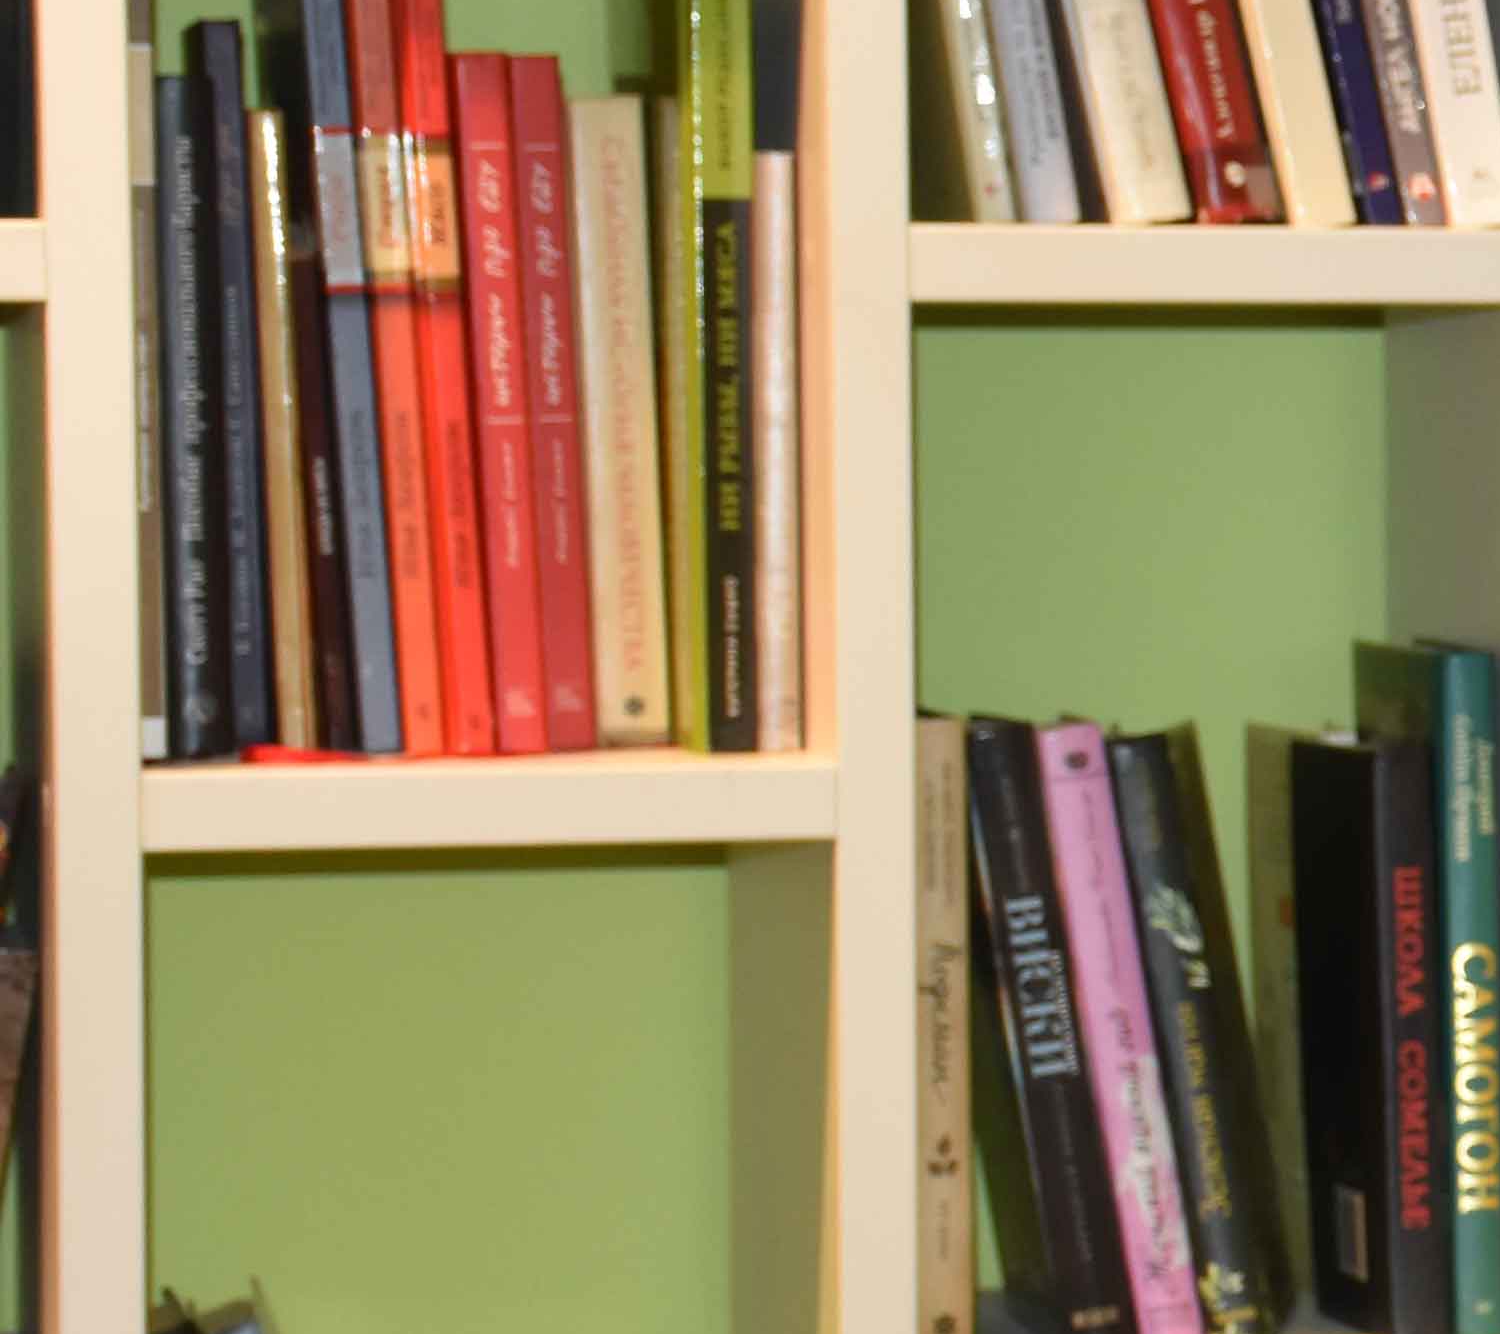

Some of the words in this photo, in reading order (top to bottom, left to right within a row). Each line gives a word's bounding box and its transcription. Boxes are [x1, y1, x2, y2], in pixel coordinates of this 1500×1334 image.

[1003, 892, 1066, 1081] ВИСКИ
[1393, 865, 1426, 1016] ШКОЛА
[1396, 1039, 1431, 1229] СОМЕЛЬЕ
[1447, 941, 1497, 1215] САМОГОН
